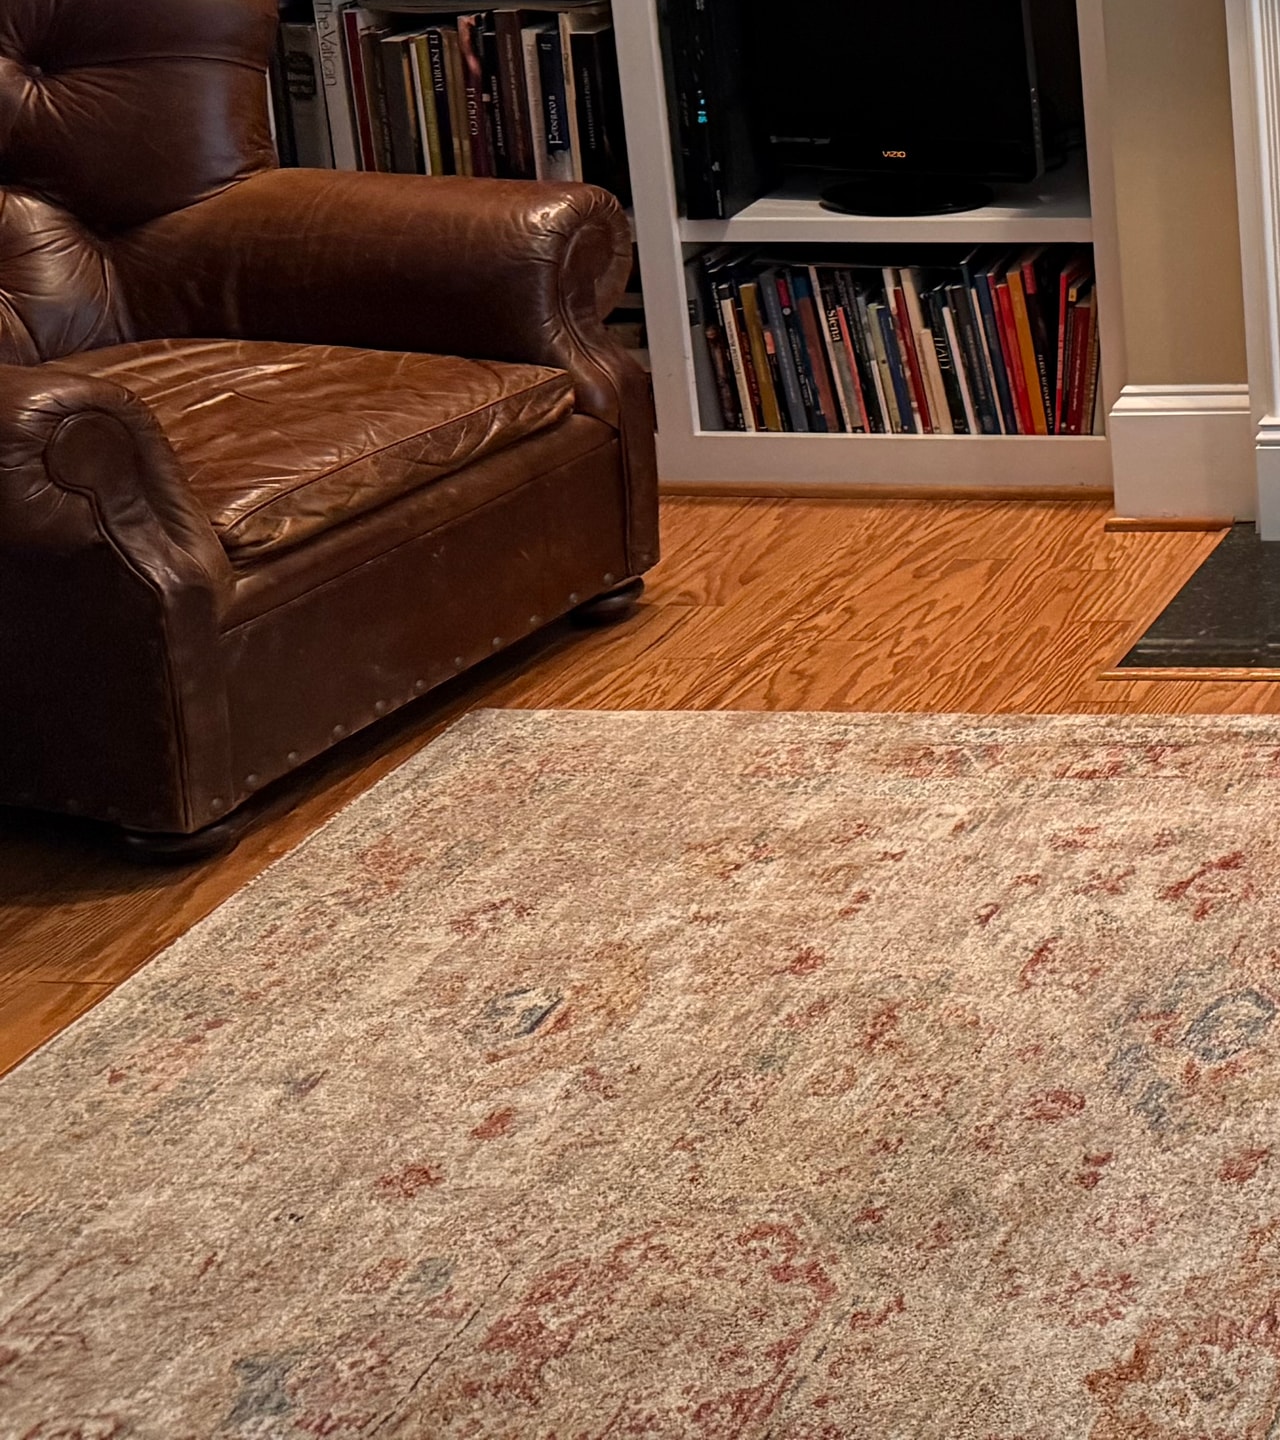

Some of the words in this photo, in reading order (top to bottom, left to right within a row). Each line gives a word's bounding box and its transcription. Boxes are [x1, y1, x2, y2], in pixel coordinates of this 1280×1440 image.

[316, 0, 333, 30] The
[319, 29, 338, 87] Vatican
[430, 48, 444, 92] ESCORIAL
[882, 150, 906, 158] VIZIO
[826, 309, 842, 342] Siena
[933, 336, 951, 372] ITALY
